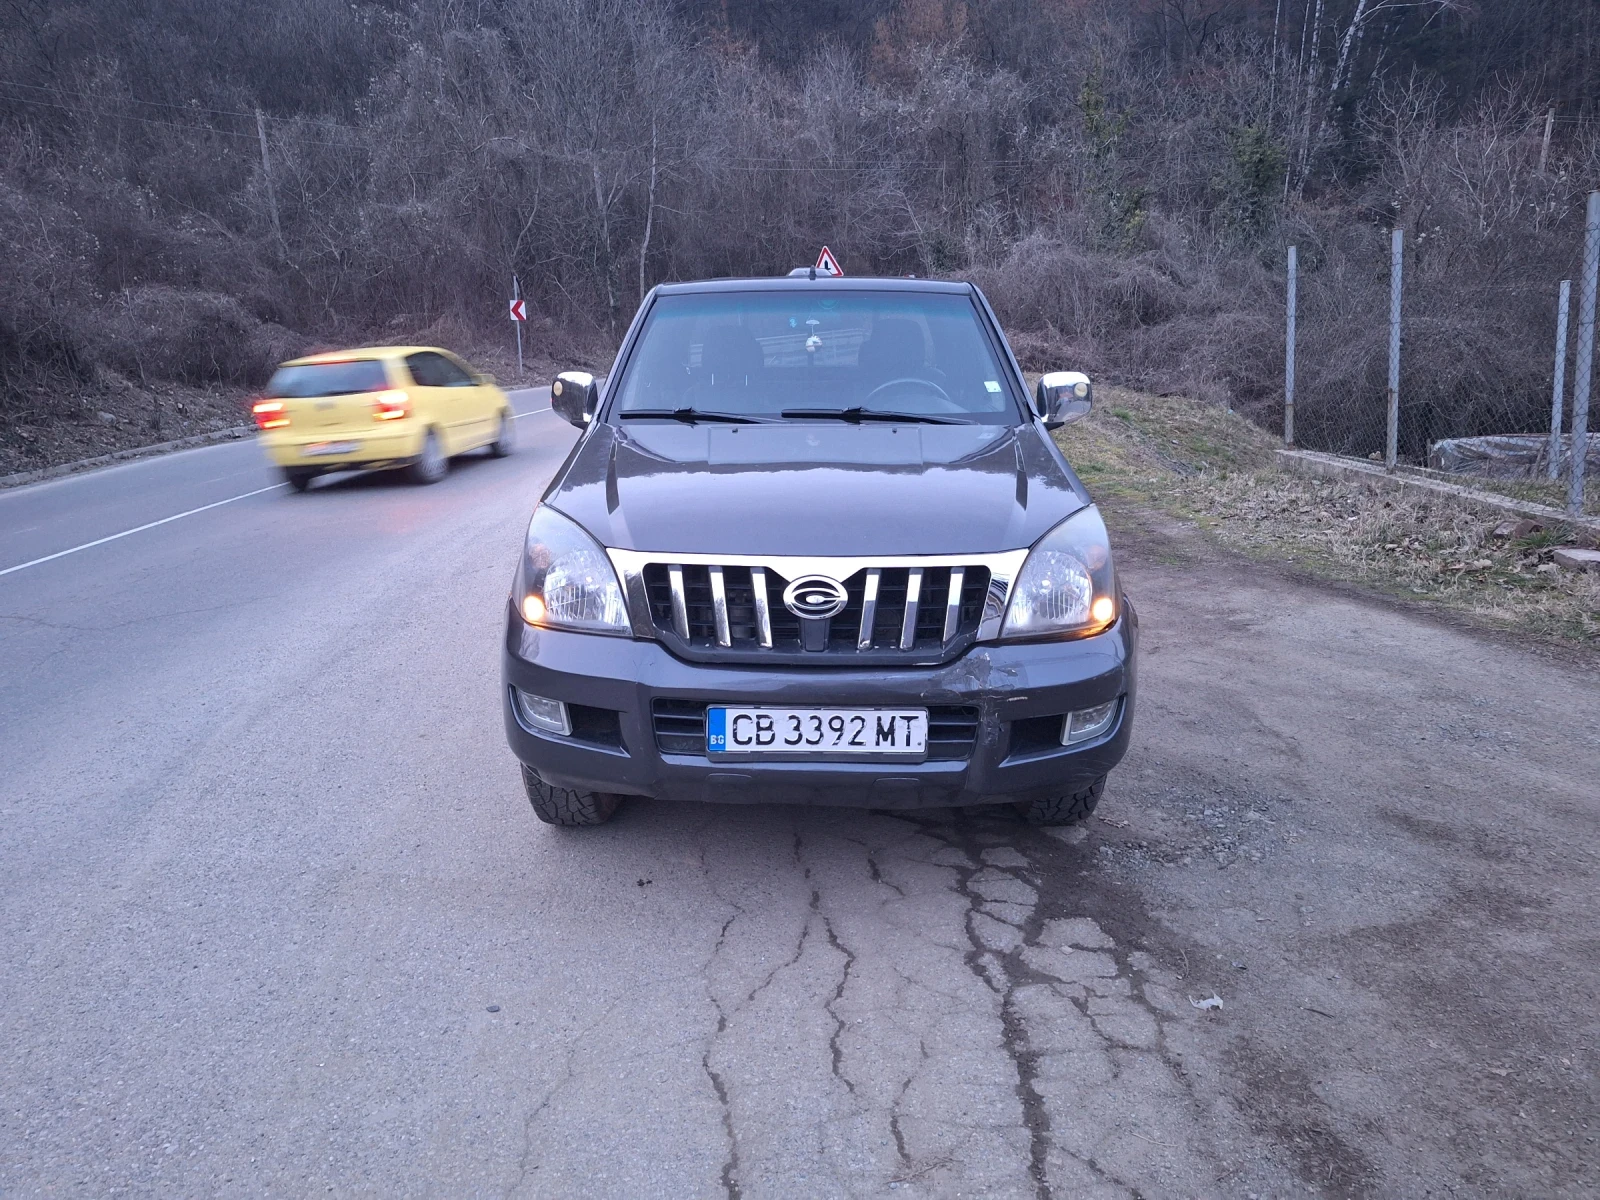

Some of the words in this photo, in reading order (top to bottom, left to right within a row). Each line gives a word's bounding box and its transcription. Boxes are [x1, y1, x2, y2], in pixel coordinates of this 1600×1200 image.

[710, 734, 725, 745] BG
[732, 714, 776, 746] CB
[784, 714, 867, 746] 3392
[875, 715, 919, 747] MT
